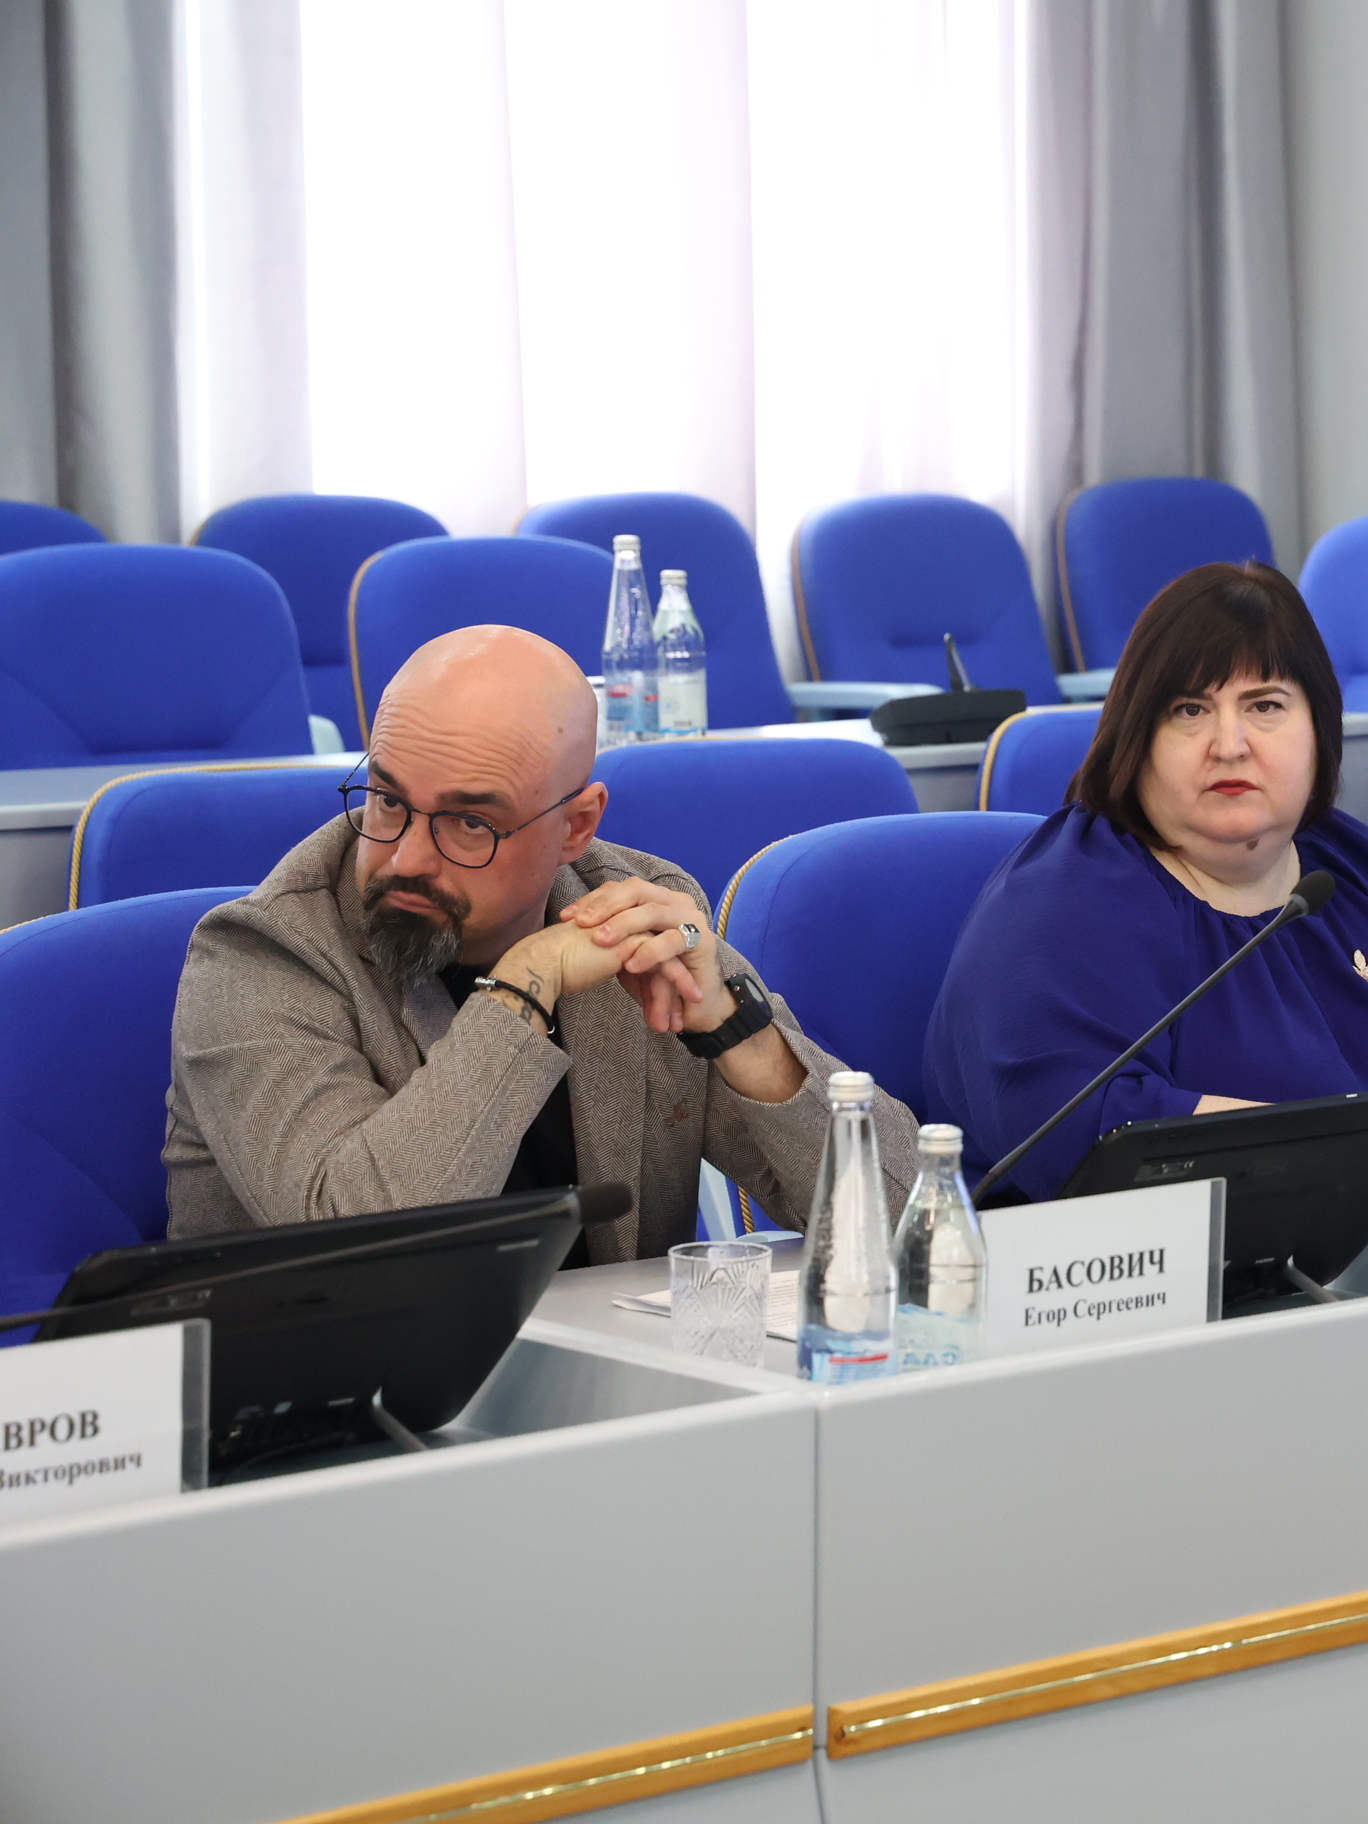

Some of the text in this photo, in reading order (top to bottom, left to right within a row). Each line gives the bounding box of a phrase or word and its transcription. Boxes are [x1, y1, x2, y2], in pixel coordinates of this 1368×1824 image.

[1026, 1247, 1166, 1294] БАСОВИЧ
[1024, 1291, 1167, 1328] Егор Сергеевич
[3, 1409, 101, 1451] ВРОВ
